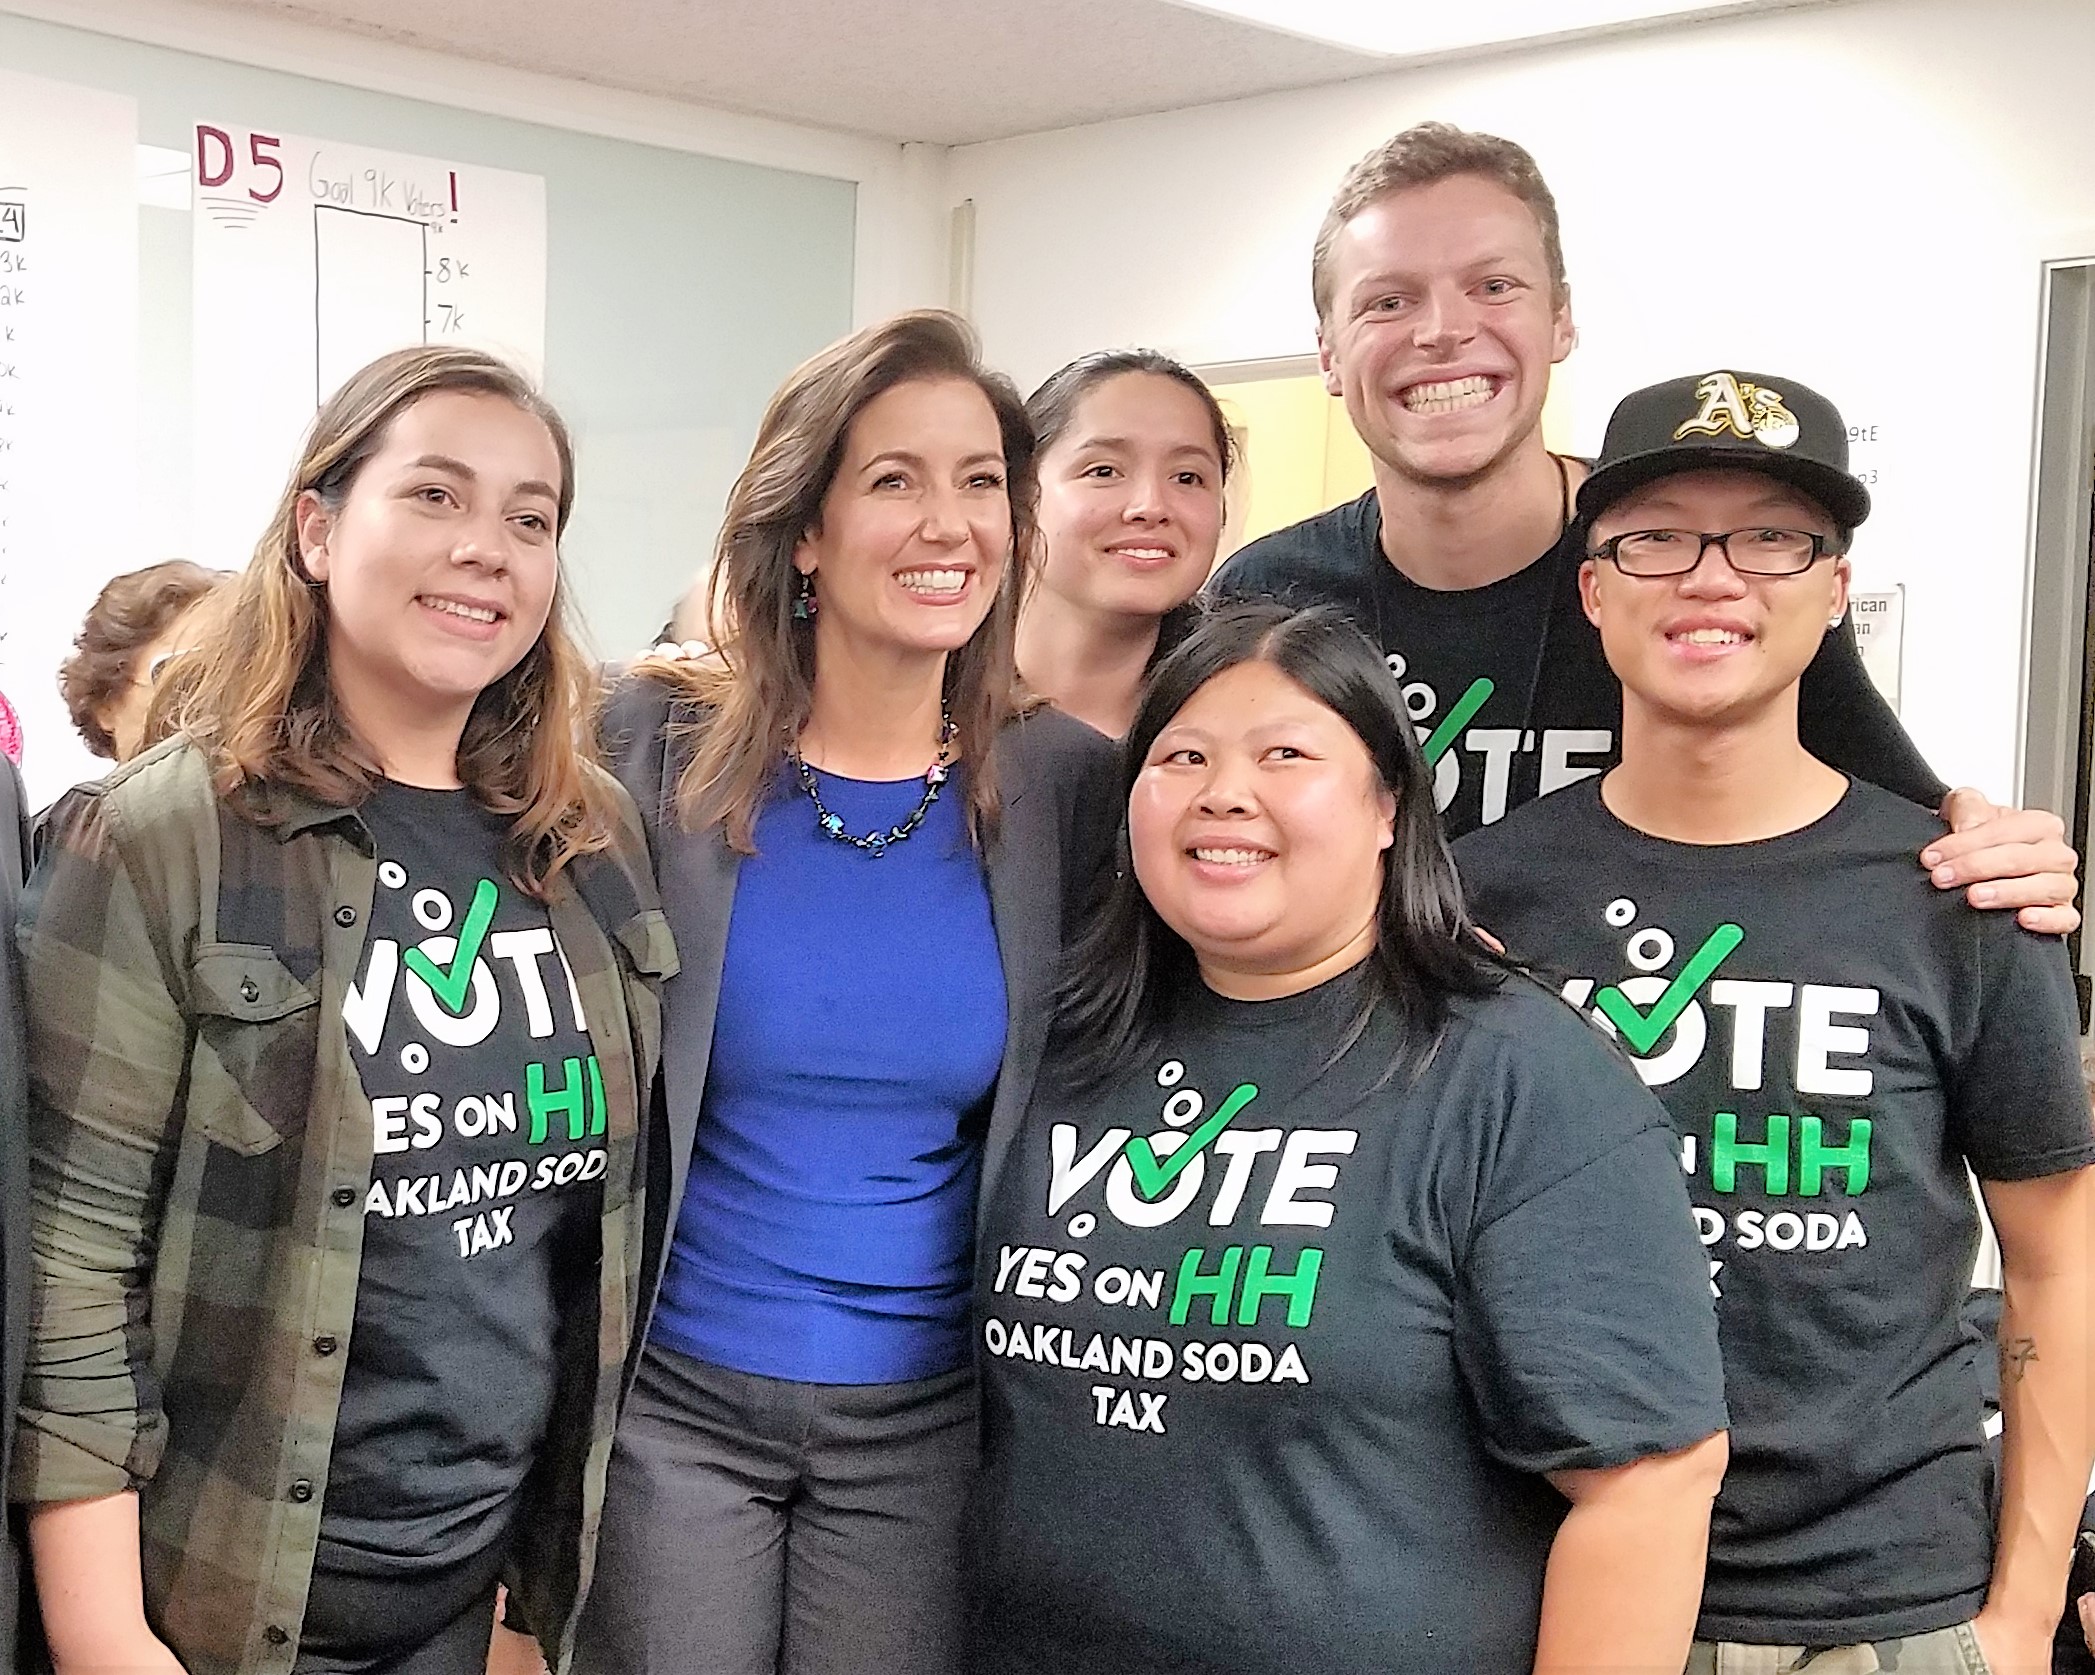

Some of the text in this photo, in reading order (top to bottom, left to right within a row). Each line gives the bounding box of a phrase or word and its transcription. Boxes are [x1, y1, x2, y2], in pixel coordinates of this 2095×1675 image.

[309, 151, 353, 204] Goal
[372, 1093, 443, 1154] ES
[454, 1093, 519, 1137] ON
[1711, 1112, 1873, 1196] HH
[364, 1149, 608, 1218] AKLAND SOD
[1047, 1123, 1360, 1228] VOTE
[452, 1206, 515, 1259] TAX
[1736, 1210, 1868, 1252] SODA
[993, 1244, 1324, 1328] YES ON HH
[984, 1318, 1310, 1385] OAKLAND SODA
[1091, 1385, 1168, 1434] TAX
